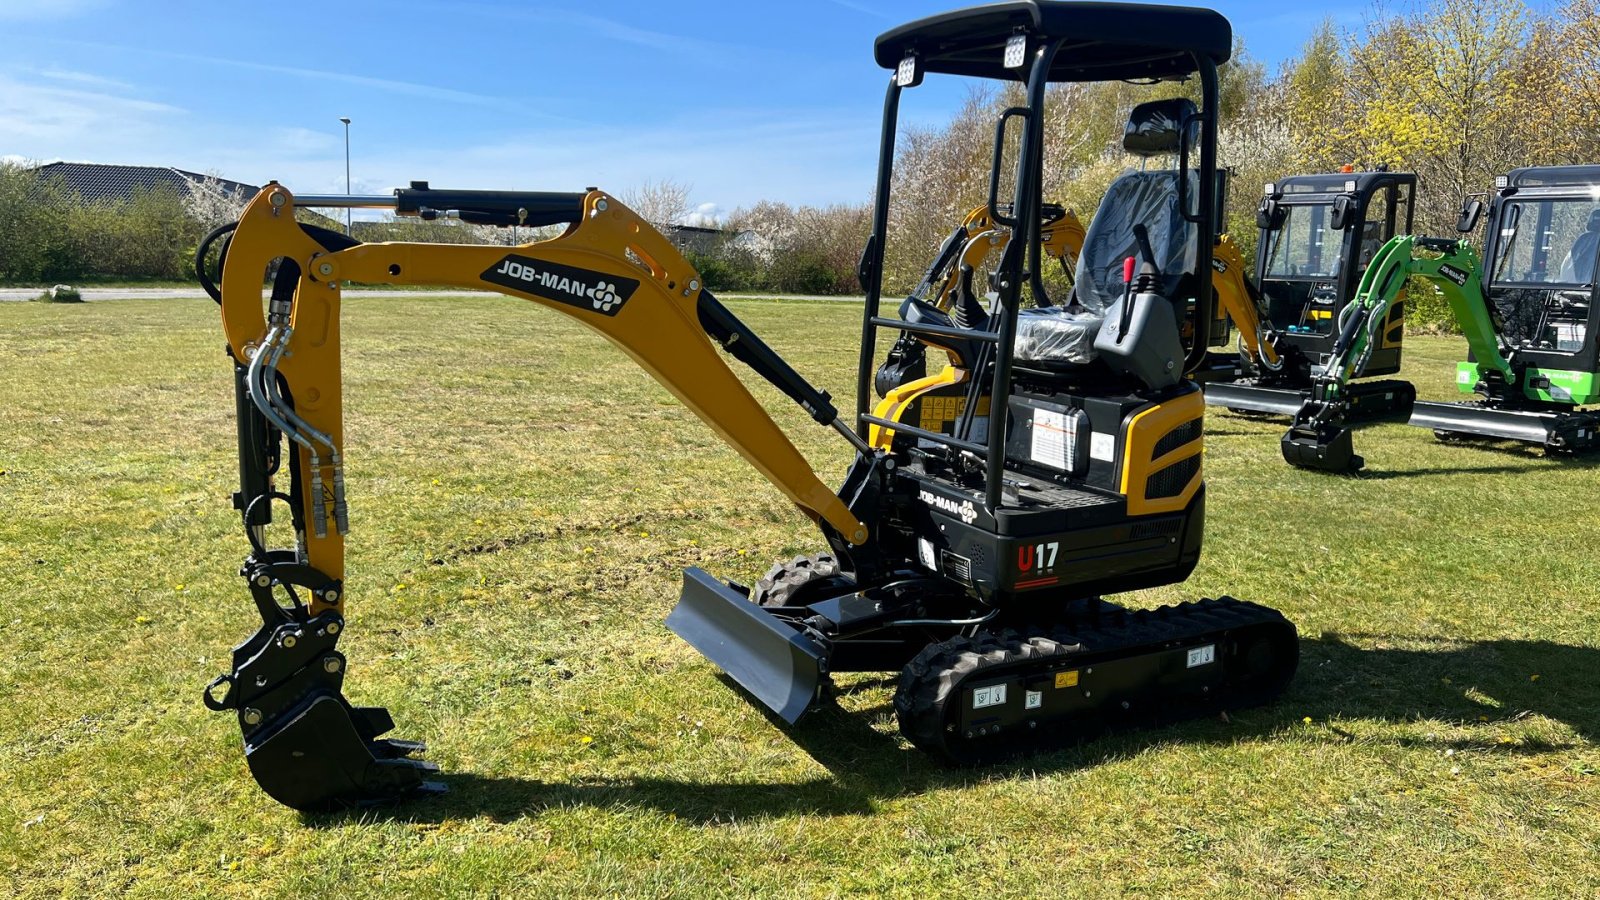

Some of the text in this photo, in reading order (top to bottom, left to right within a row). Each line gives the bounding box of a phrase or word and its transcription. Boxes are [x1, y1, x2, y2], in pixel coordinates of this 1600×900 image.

[497, 260, 586, 297] JOB-MAN
[917, 489, 958, 514] JOB-MAN
[1018, 541, 1059, 571] U17
